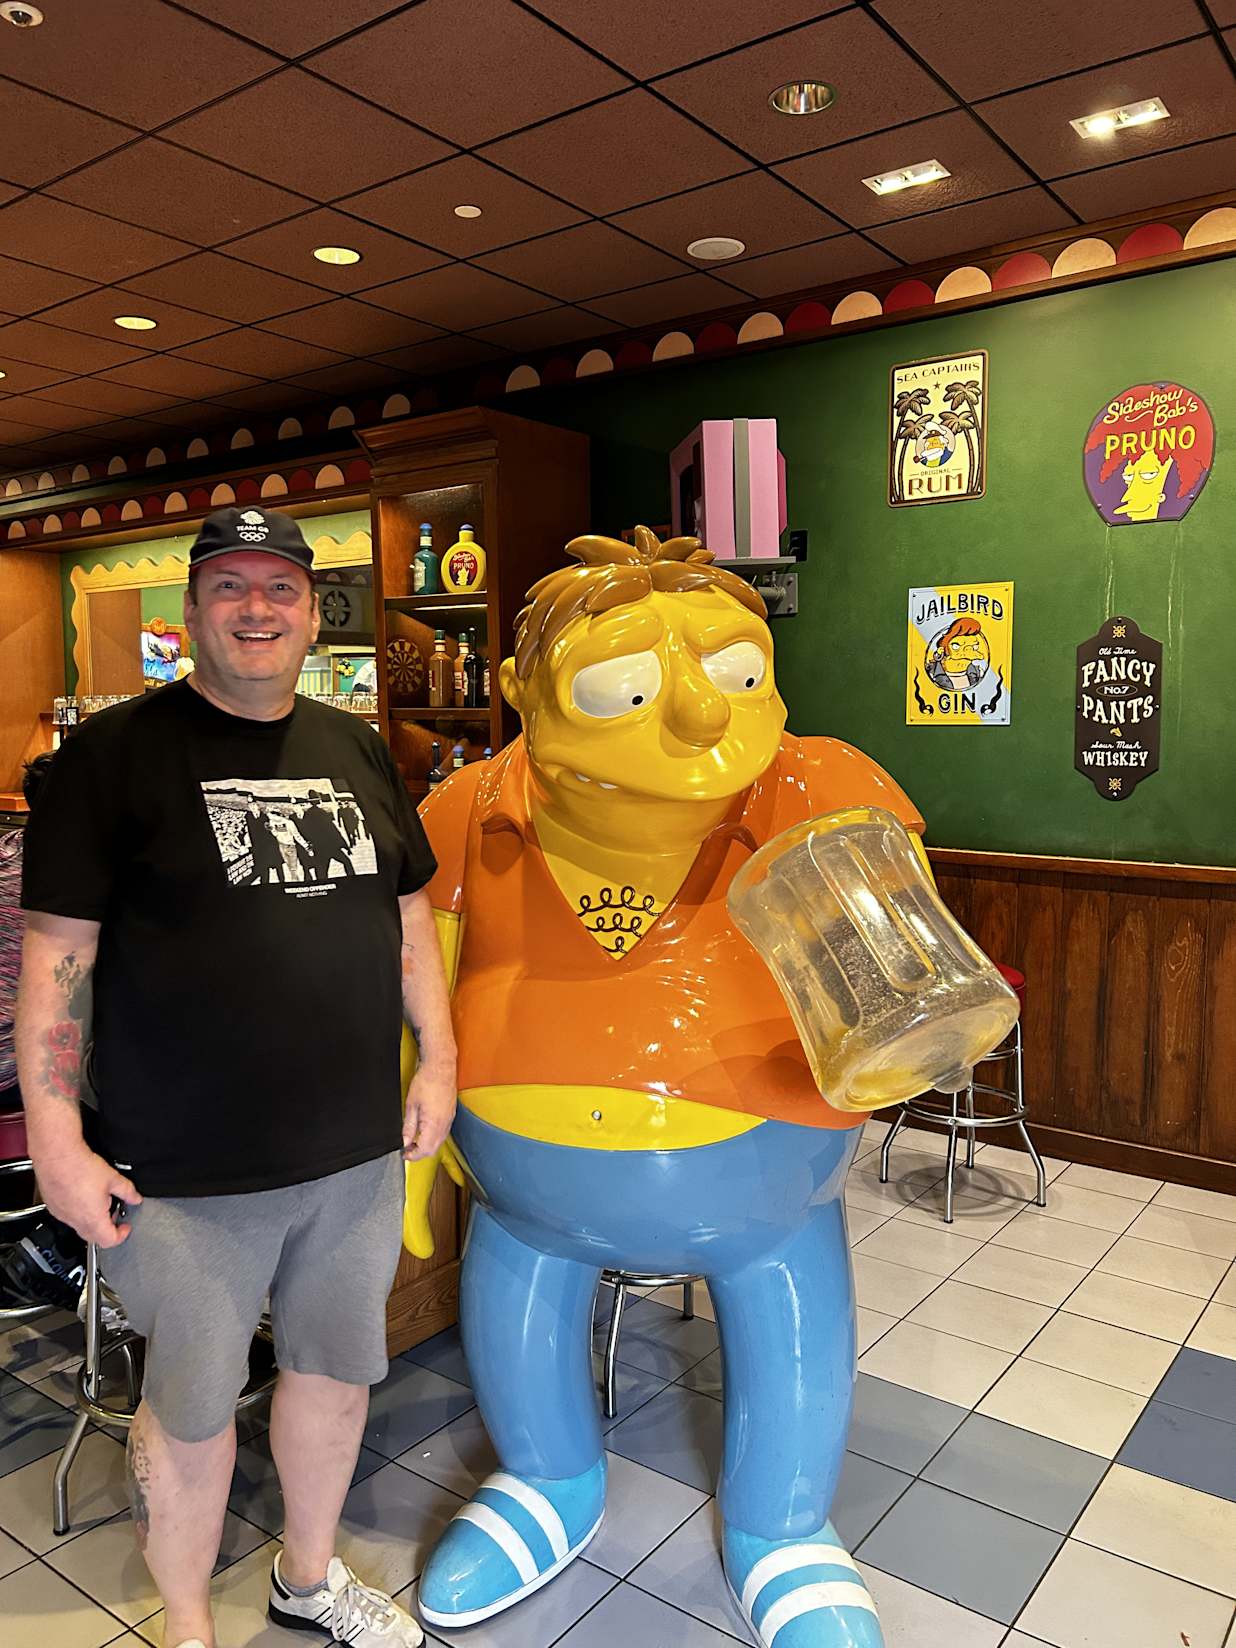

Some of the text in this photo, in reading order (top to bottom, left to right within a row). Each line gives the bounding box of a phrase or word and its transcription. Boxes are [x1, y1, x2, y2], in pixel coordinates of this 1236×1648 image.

[896, 372, 918, 384] SEA
[1102, 389, 1184, 425] Sideshow
[1104, 424, 1196, 460] PRUNO
[920, 468, 951, 477] ORIGINAL
[908, 473, 963, 496] RUM
[916, 593, 1004, 624] JAILBIRD
[1098, 646, 1137, 655] Old Time
[1081, 656, 1156, 688] FANCY
[938, 692, 977, 714] GIN
[1081, 694, 1154, 725] PANTS
[1082, 750, 1149, 767] WHISKEY
